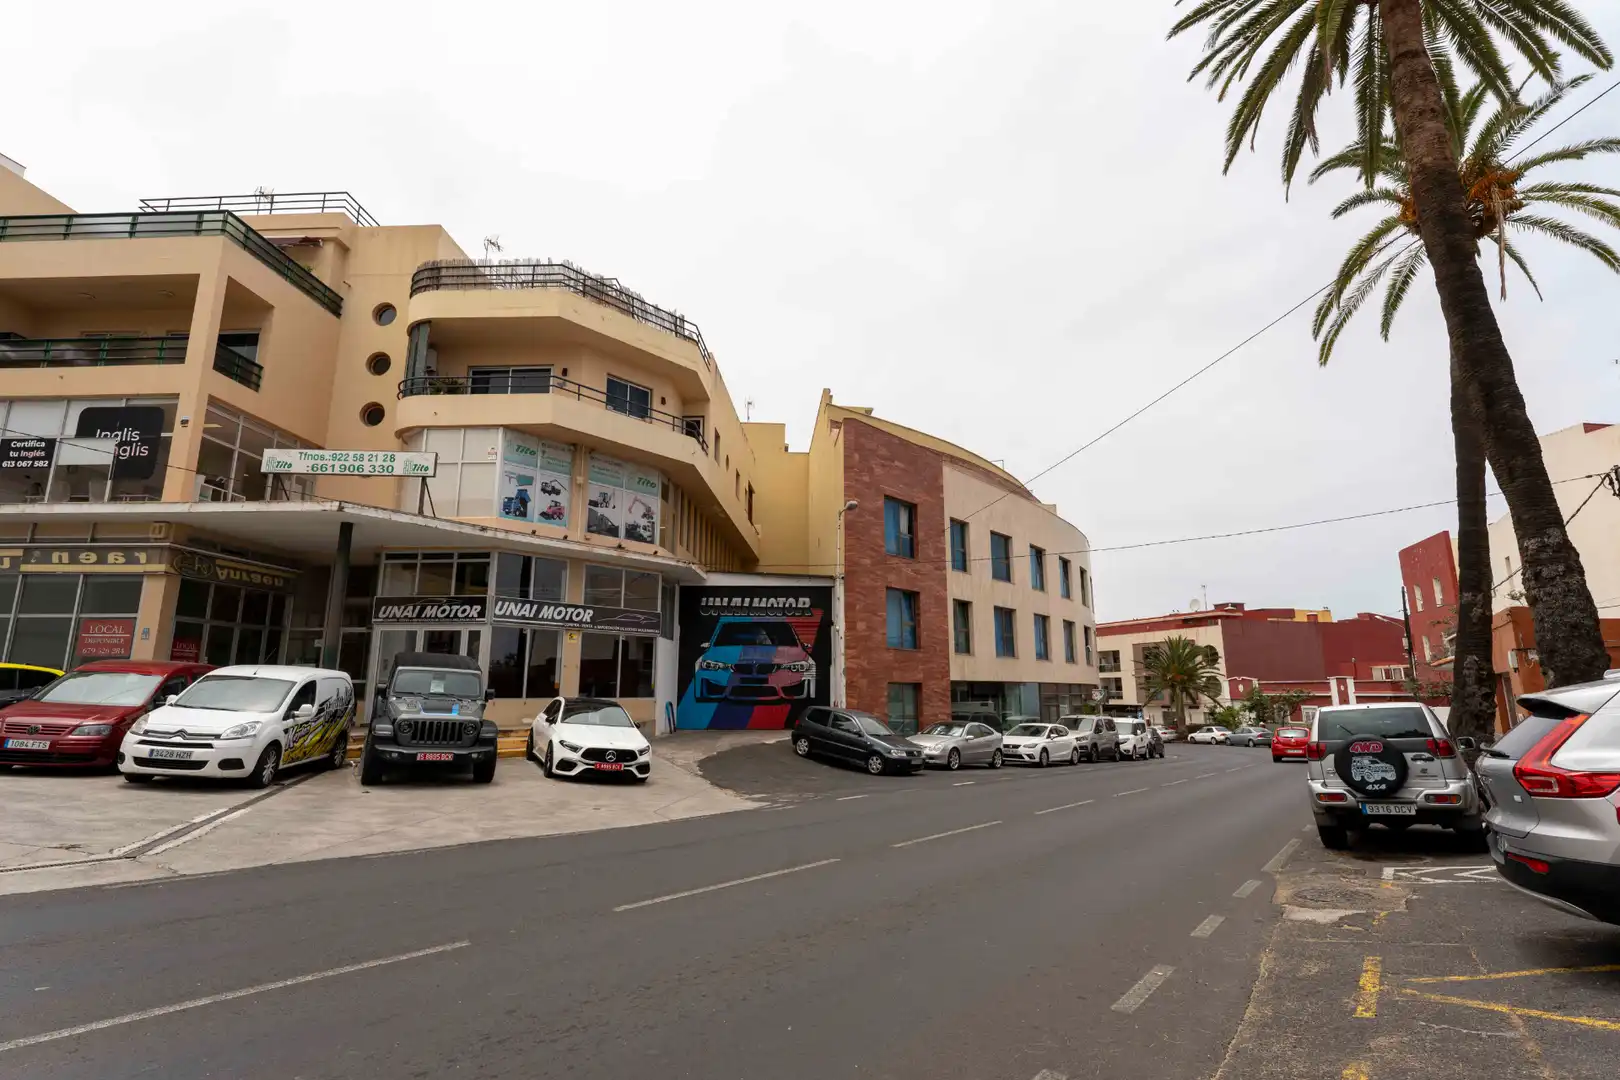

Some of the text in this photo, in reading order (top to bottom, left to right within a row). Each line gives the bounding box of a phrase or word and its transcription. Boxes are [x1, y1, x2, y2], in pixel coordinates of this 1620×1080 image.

[11, 440, 46, 448] Certifica
[20, 449, 46, 458] Inglés
[515, 444, 537, 456] Tito
[352, 453, 365, 462] 58
[367, 454, 379, 463] 21
[382, 454, 396, 463] 28
[2, 460, 15, 468] 613
[16, 460, 33, 468] 067
[275, 460, 293, 469] Tito
[368, 464, 395, 474] 330
[411, 463, 430, 472] Tito
[636, 477, 657, 489] Tito
[700, 597, 811, 615] UNAI MOTOR
[379, 605, 482, 618] UNAI MOTOR
[494, 600, 595, 623] UNAI MOTOR
[89, 624, 125, 634] LOCAL
[10, 740, 48, 749] 1084 FTS
[1350, 742, 1383, 753] 4WD
[1368, 805, 1392, 814] 9316
